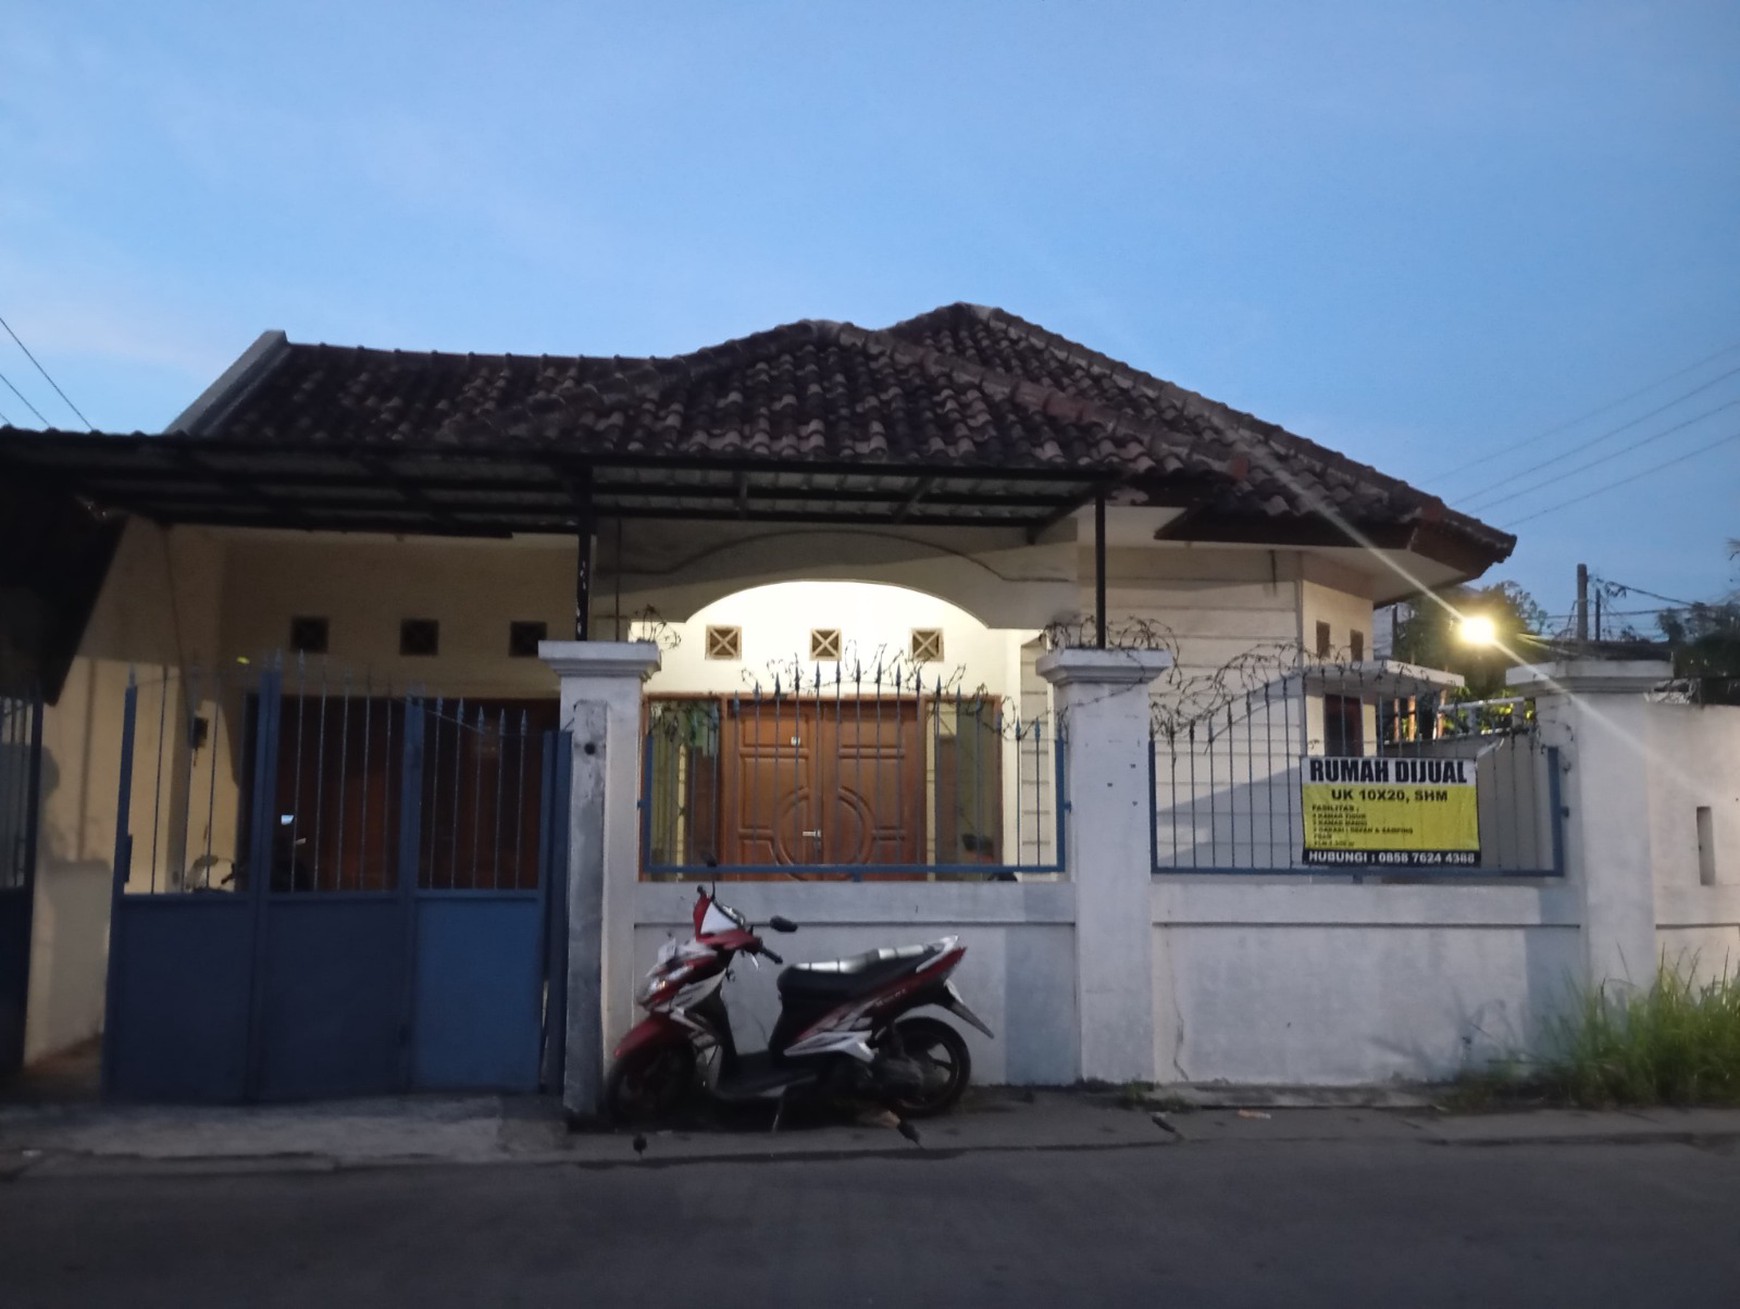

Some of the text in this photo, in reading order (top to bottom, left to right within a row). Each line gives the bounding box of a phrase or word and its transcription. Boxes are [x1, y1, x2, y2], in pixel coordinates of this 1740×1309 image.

[1310, 759, 1467, 783] RUMAH DIJUAL
[1331, 789, 1448, 804] UK 10X20, SHM
[1309, 851, 1368, 863] HUBUNGI
[1411, 852, 1442, 864] 7624
